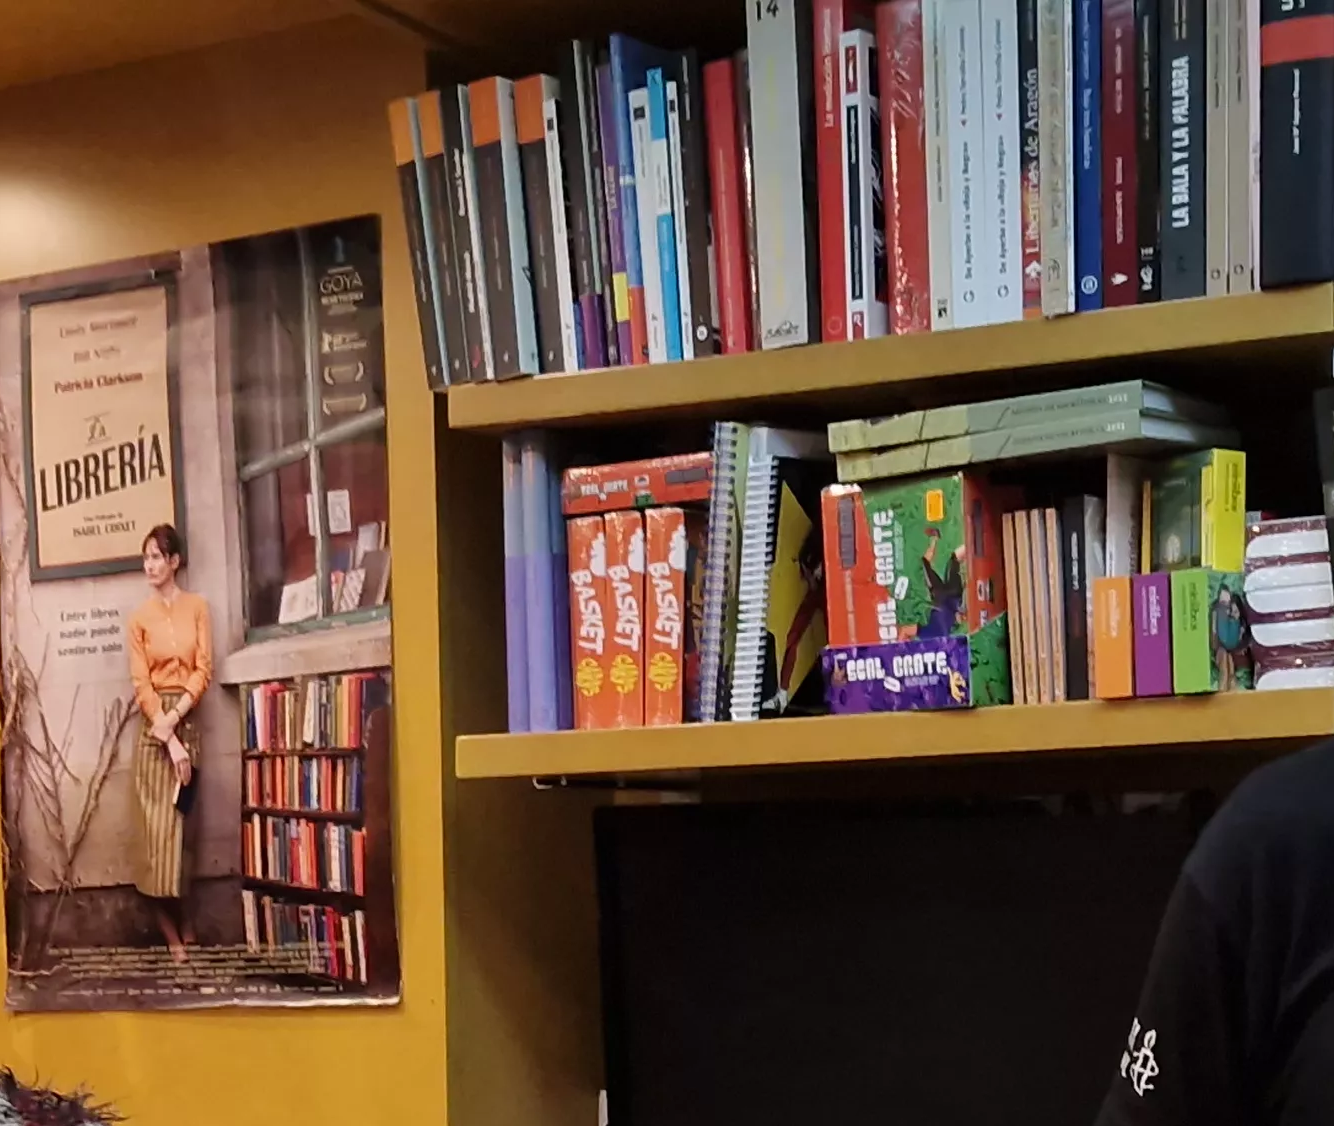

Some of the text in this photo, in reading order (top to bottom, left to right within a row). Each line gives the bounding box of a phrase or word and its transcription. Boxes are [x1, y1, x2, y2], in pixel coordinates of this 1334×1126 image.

[1022, 68, 1039, 157] de Aragón
[1170, 56, 1190, 228] LA BALA Y LA PALABRA
[319, 271, 364, 294] GOYA
[54, 371, 144, 395] Patricia Clarkson
[38, 424, 166, 512] LIBRERÍA
[570, 568, 604, 656] BASKET
[607, 564, 641, 652] BASKET
[648, 561, 682, 650] BASKET
